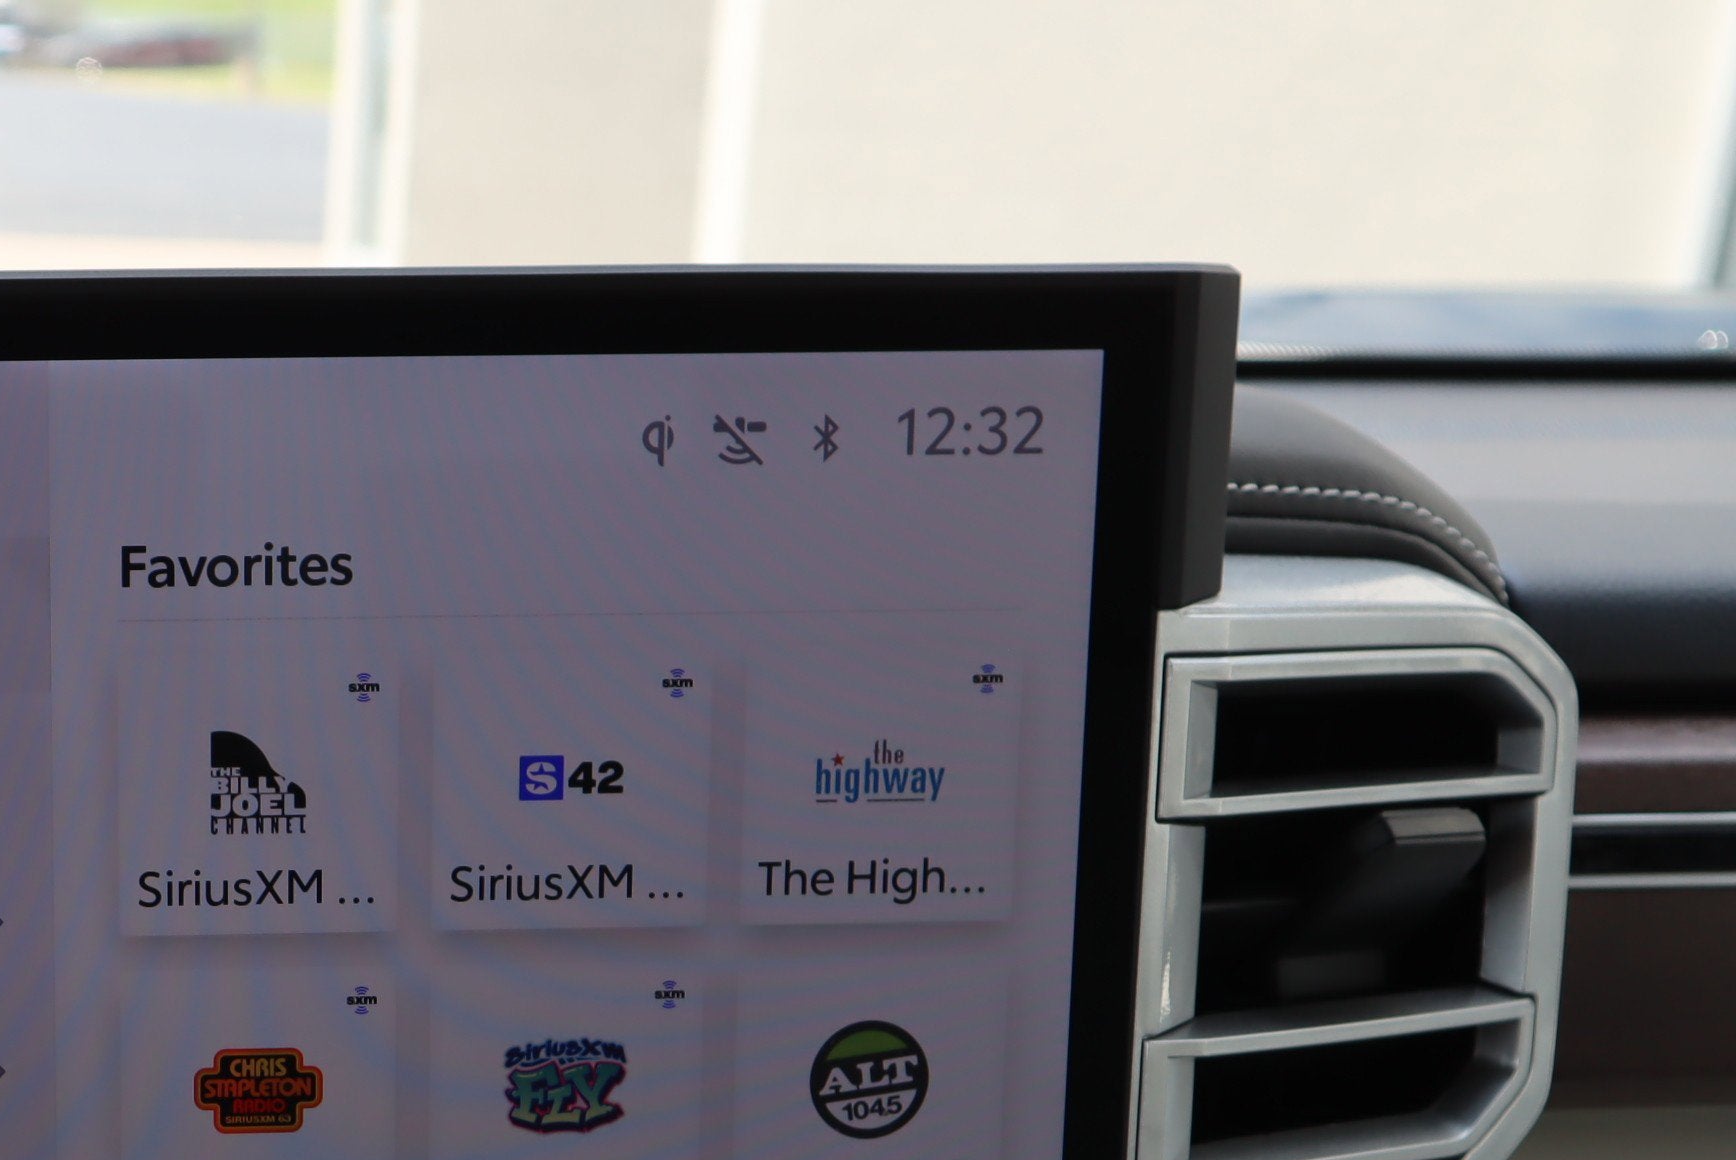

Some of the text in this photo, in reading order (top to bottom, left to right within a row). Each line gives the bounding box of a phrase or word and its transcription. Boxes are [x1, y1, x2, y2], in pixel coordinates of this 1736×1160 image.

[897, 405, 1044, 457] 12:32
[122, 541, 354, 589] Favorites
[874, 739, 904, 764] the
[210, 776, 289, 794] BILLY
[815, 755, 945, 803] highway
[210, 793, 306, 817] JOEL
[210, 817, 306, 835] CHANNEL
[138, 869, 323, 908] SiriusXM
[450, 863, 634, 903] SiriusXM
[758, 859, 835, 897] The
[230, 1058, 287, 1078] CHRIS
[819, 1055, 918, 1096] ALT
[204, 1078, 312, 1099] STAPLETON
[505, 1060, 626, 1133] FLY
